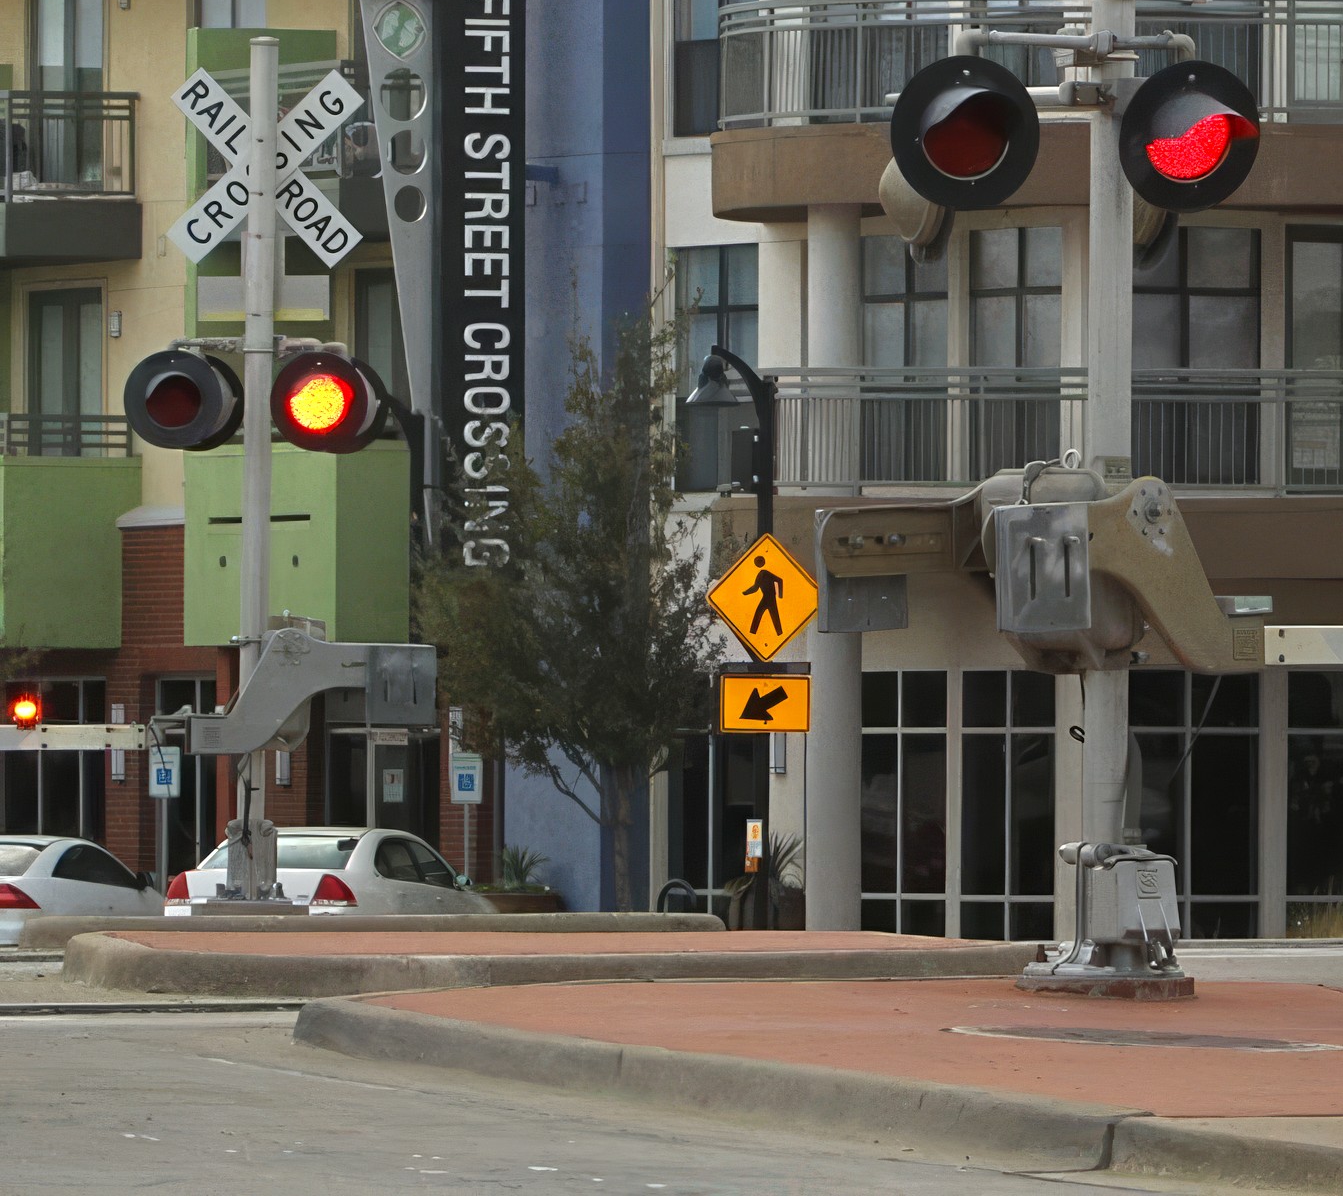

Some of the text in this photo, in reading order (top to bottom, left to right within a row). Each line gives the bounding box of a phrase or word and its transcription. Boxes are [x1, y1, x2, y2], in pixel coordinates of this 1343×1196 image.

[181, 79, 349, 254] RAIL ROAD
[186, 90, 344, 245] CROING
[463, 132, 512, 309] STREET
